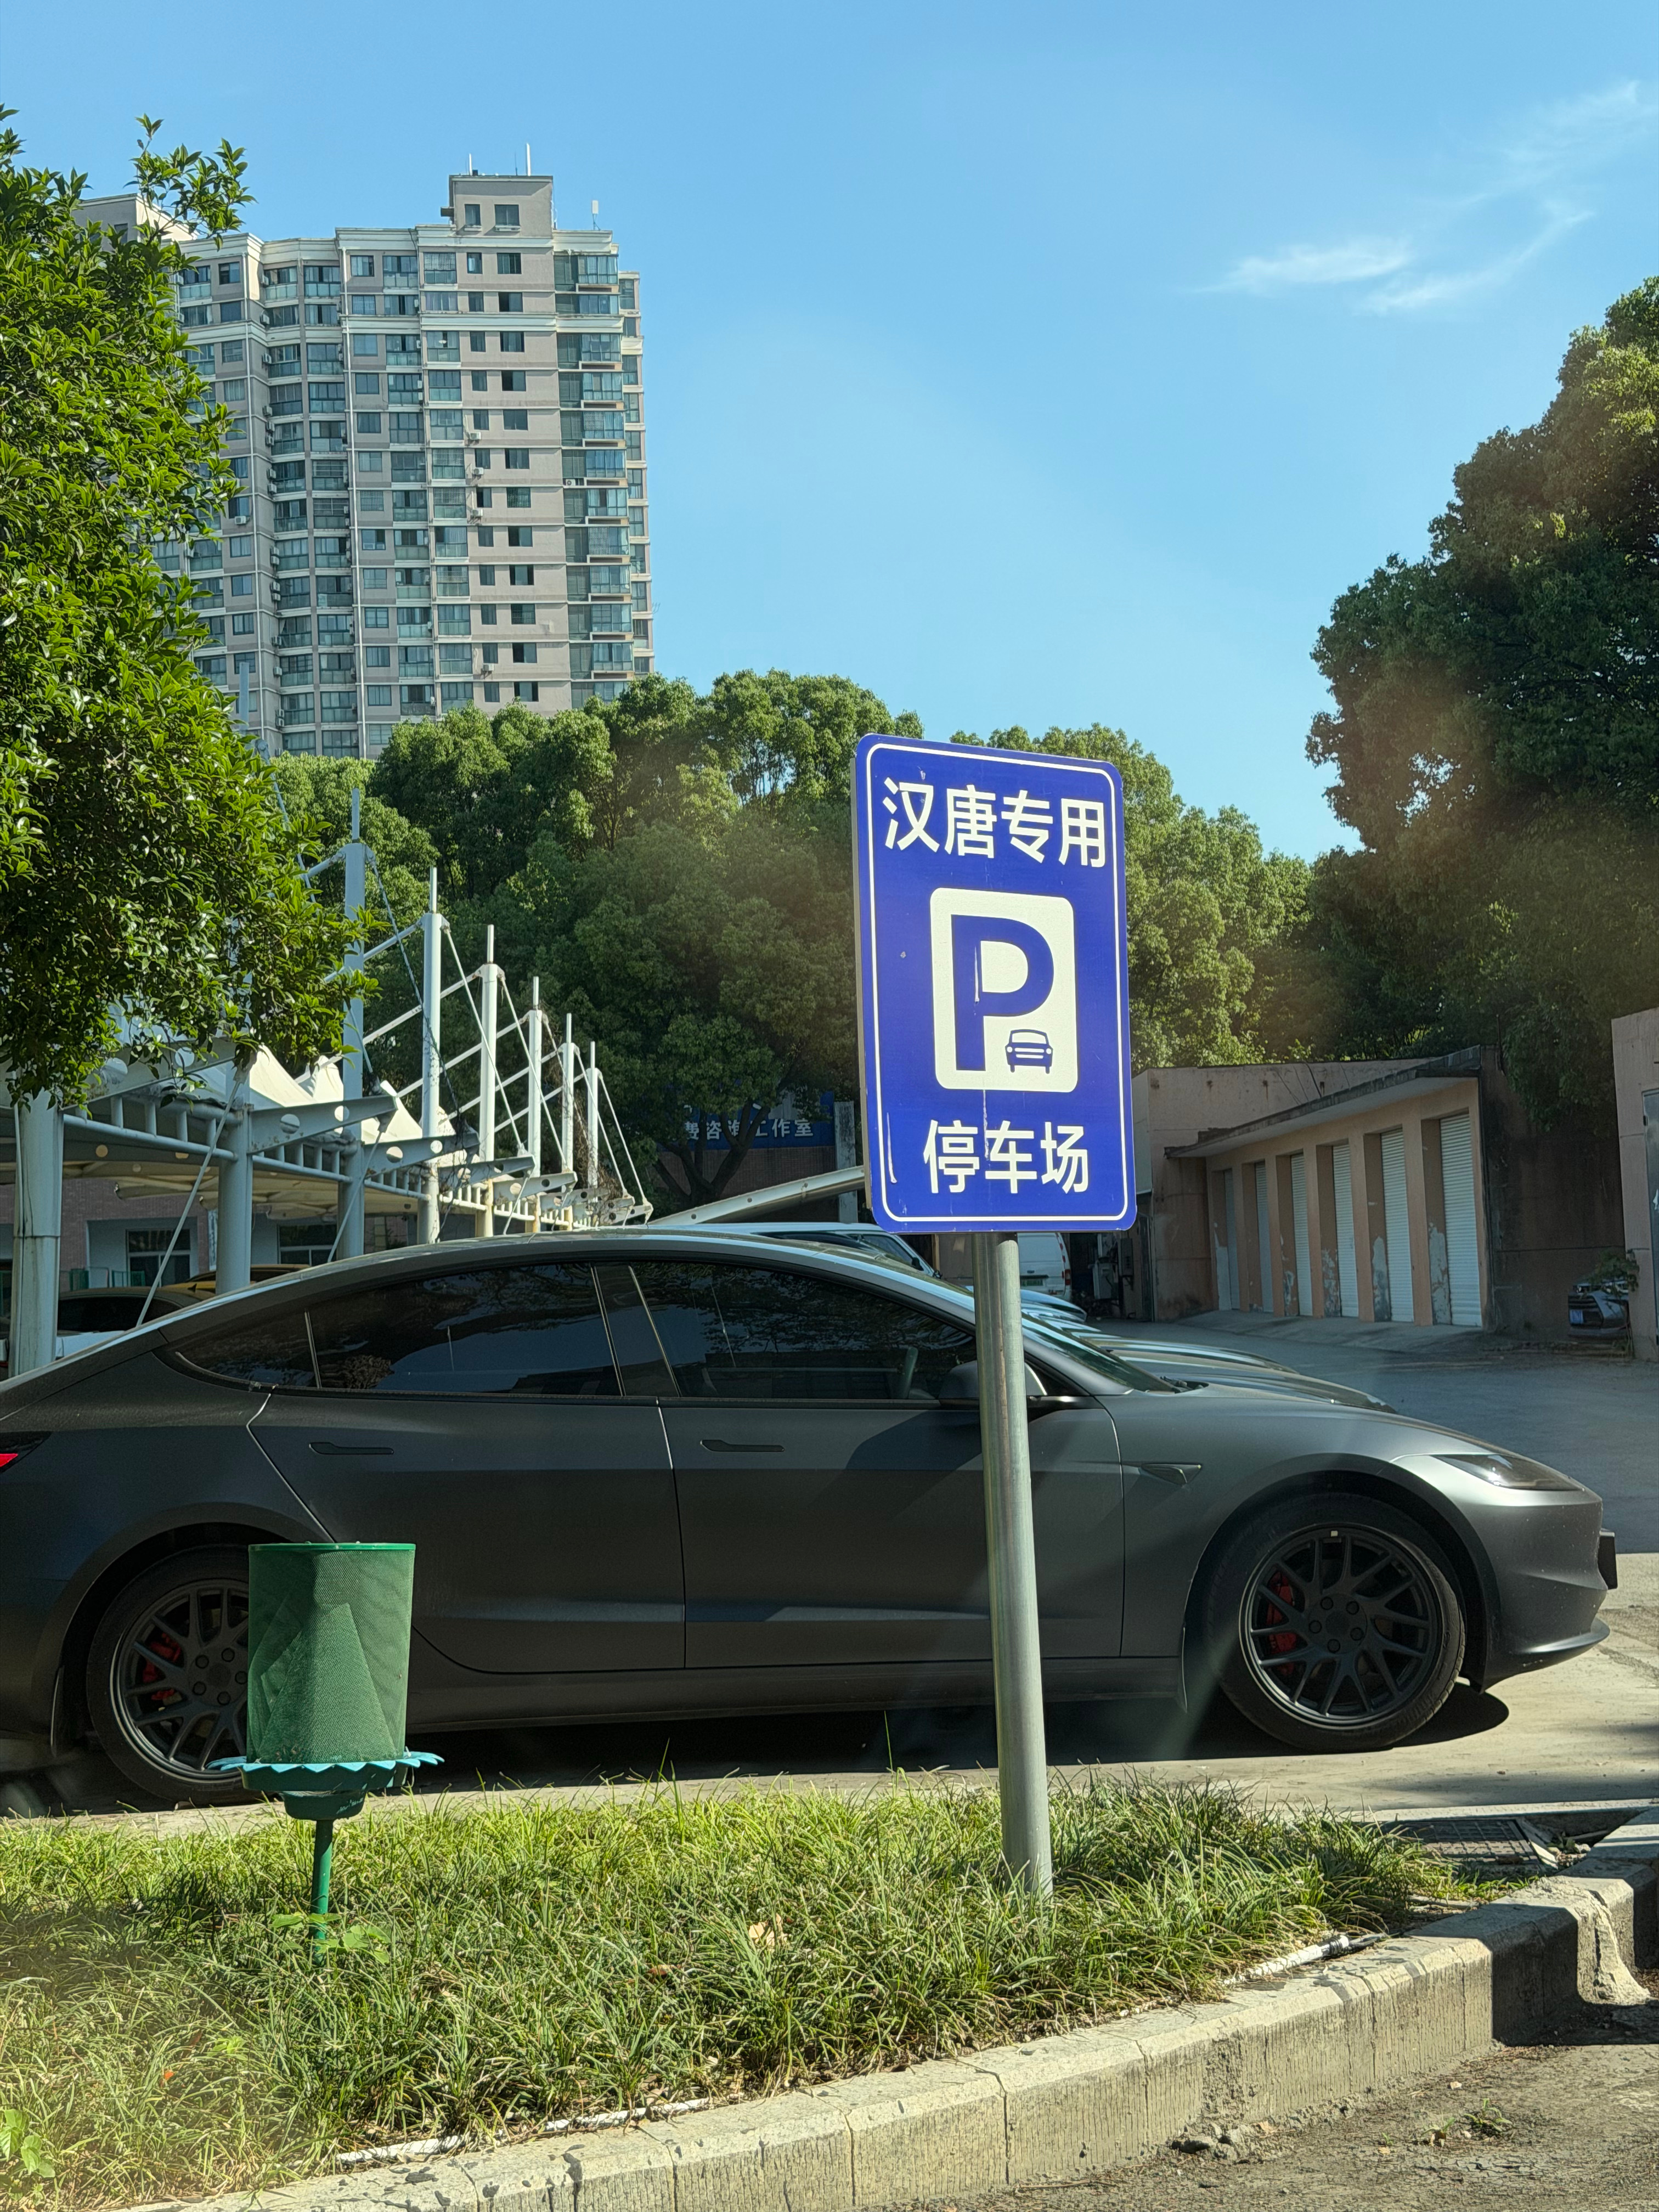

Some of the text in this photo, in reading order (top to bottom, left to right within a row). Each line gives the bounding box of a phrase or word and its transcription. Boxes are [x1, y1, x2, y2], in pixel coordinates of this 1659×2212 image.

[883, 777, 1106, 867] 汉唐专用
[951, 915, 1054, 1071] P
[923, 1120, 1089, 1194] 停车场
